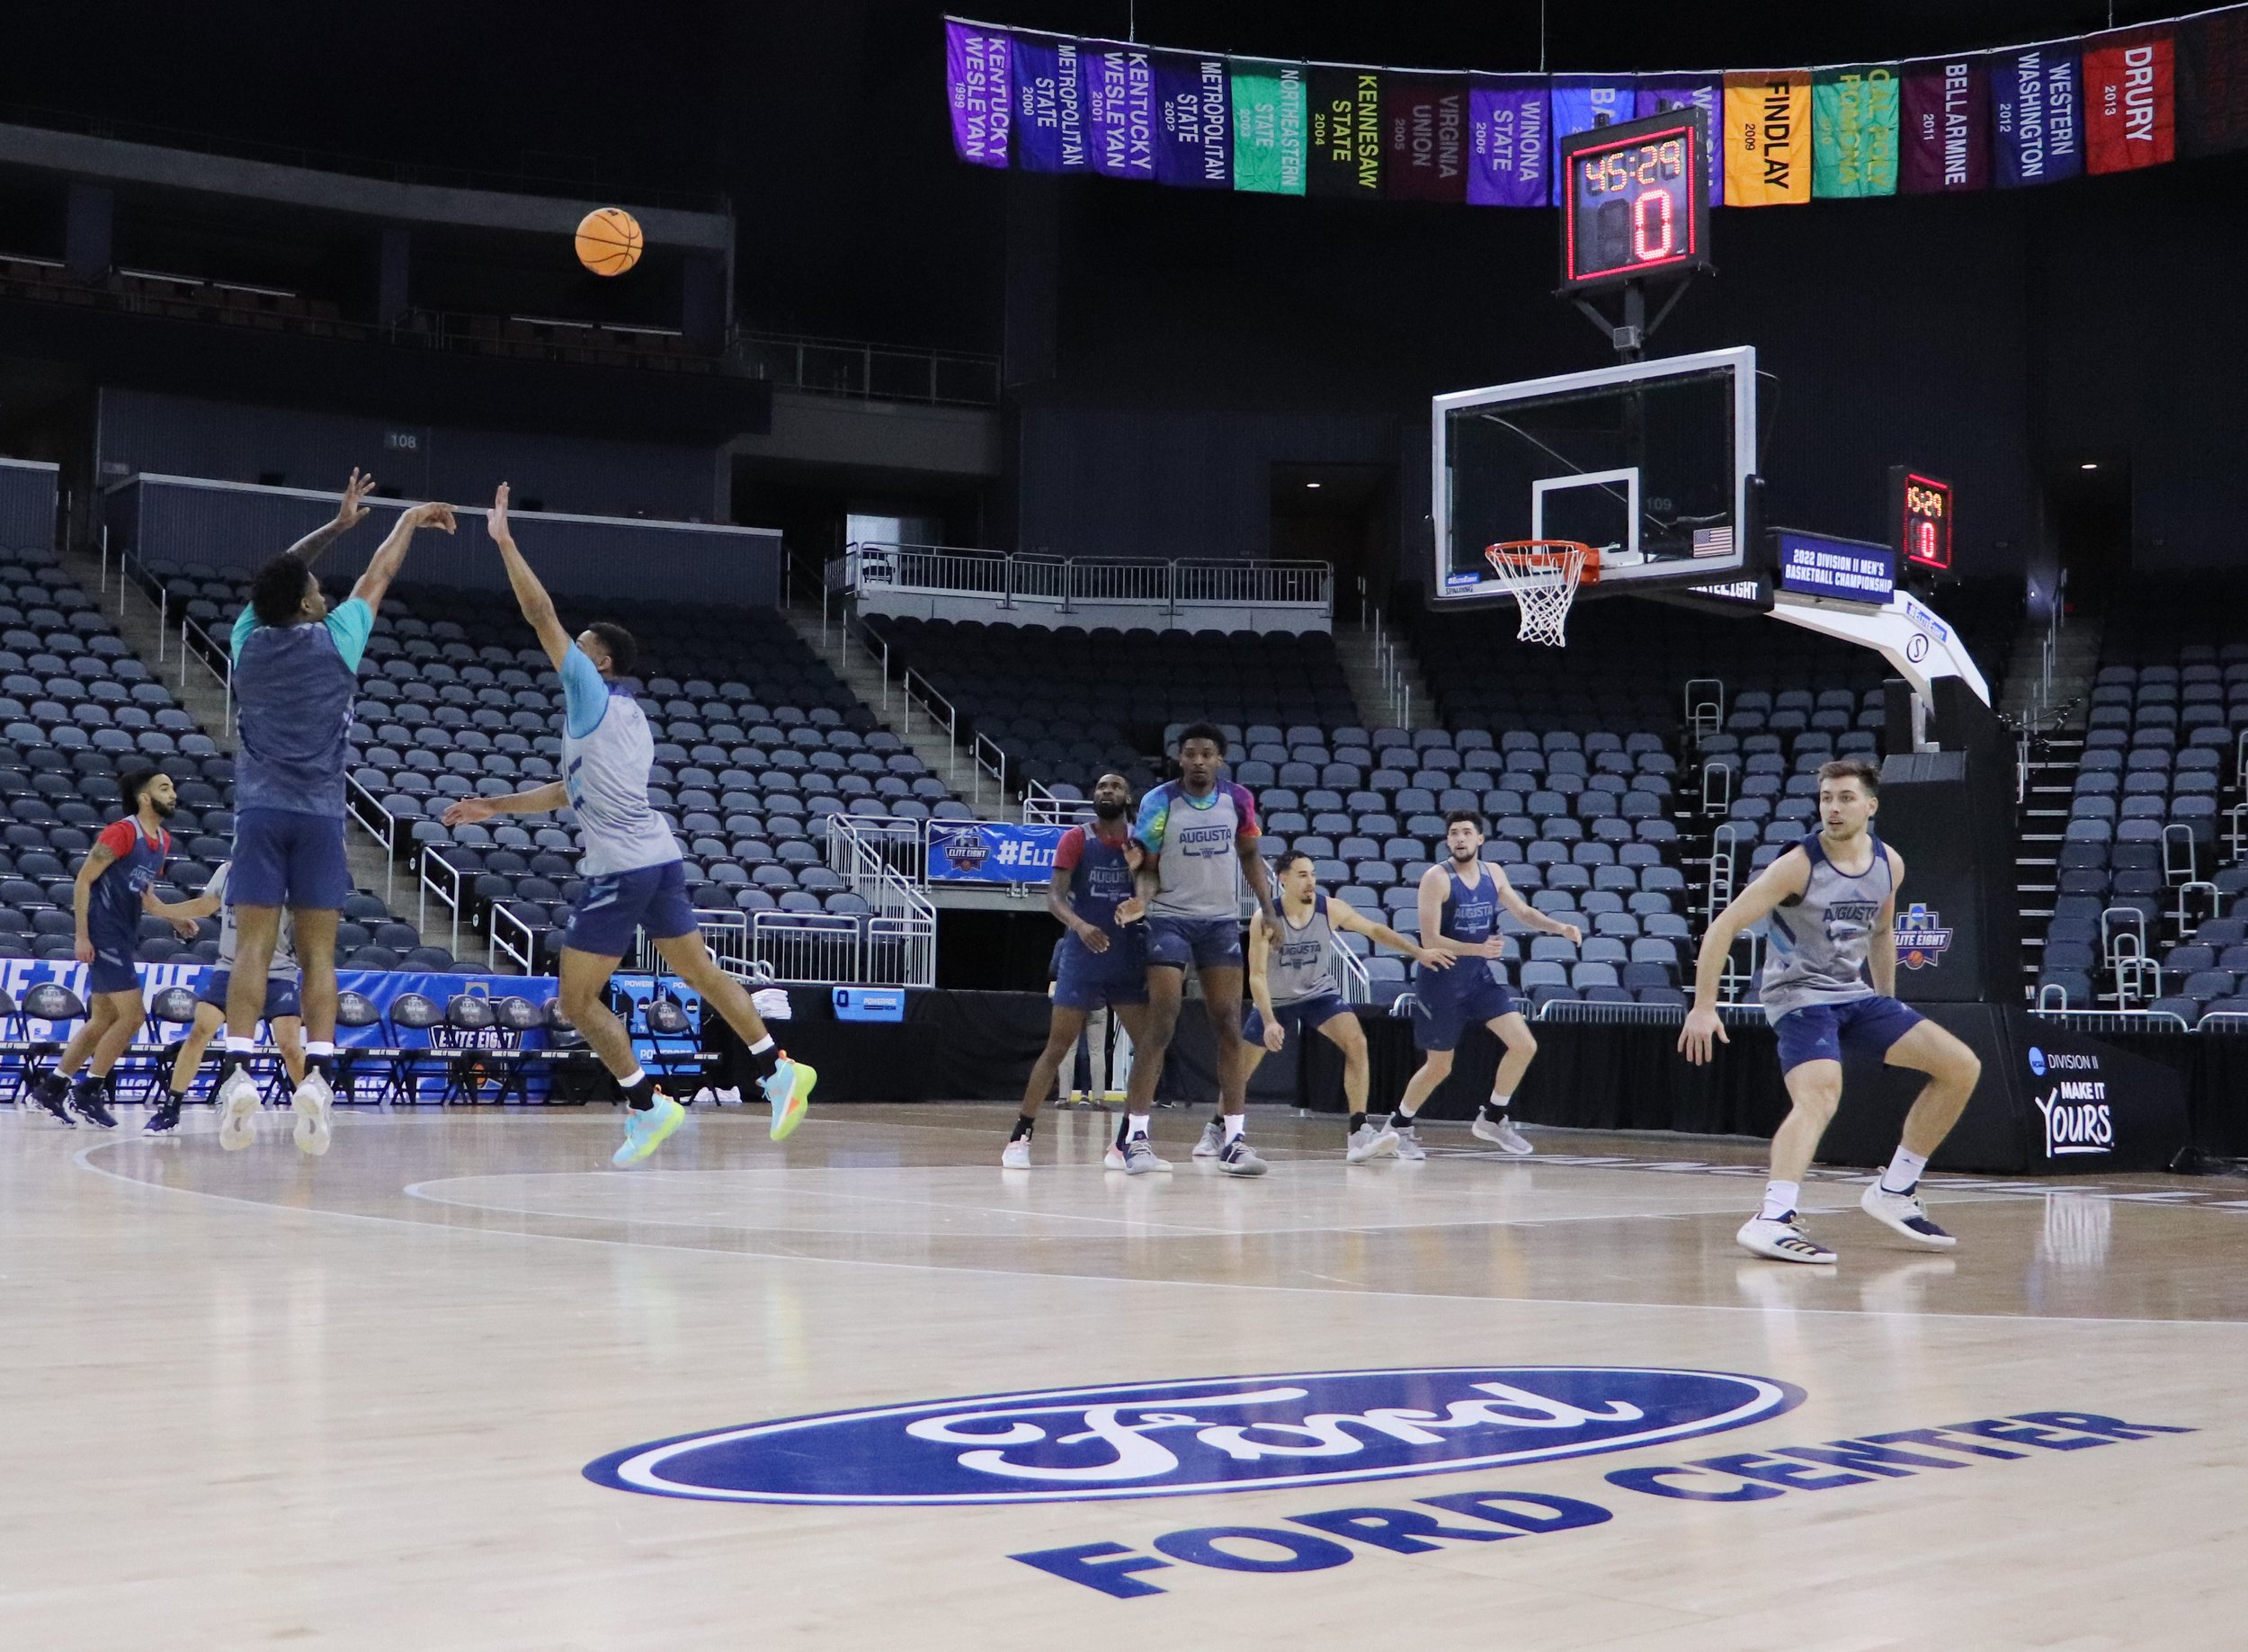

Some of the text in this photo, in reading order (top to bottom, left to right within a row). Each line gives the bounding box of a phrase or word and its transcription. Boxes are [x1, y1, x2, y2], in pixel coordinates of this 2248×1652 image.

[954, 82, 965, 109] 1999
[964, 37, 985, 157] WESLEYAN
[987, 37, 1010, 159] KENTUCKY
[1021, 86, 1034, 116] 2000
[1035, 77, 1057, 128] STATE
[1057, 44, 1084, 165] METROPOLITAN
[1091, 91, 1102, 122] 2001
[1103, 52, 1126, 168] WESLEYAN
[1128, 52, 1153, 170] KENTUCKY
[1164, 101, 1175, 132] 2002
[1177, 94, 1200, 143] STATE
[1999, 103, 2012, 133] 2012
[2018, 51, 2044, 178] WASHINGTON
[2048, 63, 2073, 155] WESTERN
[2104, 85, 2117, 116] 2013
[2125, 46, 2154, 141] DRURY
[1200, 62, 1226, 180] METROPOLITAN
[1253, 103, 1274, 147] STATE
[1280, 68, 1300, 186] NORTHEASTERN
[1315, 113, 1325, 146] 2004
[1331, 100, 1352, 162] STATE
[1356, 75, 1378, 189] KENNESAW
[1394, 118, 1405, 151] 2005
[1412, 104, 1432, 167] UNION
[1438, 94, 1459, 180] VIRGINIA
[1476, 121, 1487, 155] 2006
[1492, 110, 1512, 172] STATE
[1520, 101, 1541, 182] WINONA
[1744, 122, 1756, 151] 2009
[1763, 81, 1790, 190] FINDLAY
[1839, 74, 1861, 185] POMONA
[1868, 69, 1891, 187] CAL POLY
[1922, 113, 1934, 141] 2011
[1944, 64, 1967, 185] BELLARMINE
[1585, 140, 1681, 192] 45:29
[1635, 189, 1671, 260] 0
[391, 433, 416, 449] 108
[1793, 549, 1815, 565] 2022
[1816, 552, 1851, 569] DIVISION
[1860, 558, 1885, 576] MEN'S
[1921, 522, 1934, 558] 0
[1785, 564, 1893, 594] BASKETBALL CHAMPIONSHIP
[949, 849, 986, 858] ELITE EIGHT
[1180, 828, 1232, 844] AUGUSTA
[1454, 905, 1493, 919] AUGUSTA
[1894, 934, 1946, 946] LITE EIGHT
[2047, 1054, 2092, 1069] DIVISION
[2092, 1056, 2099, 1069] II
[2061, 1082, 2105, 1099] MAKE IT
[905, 1381, 1643, 1482] Ford
[1006, 1410, 2202, 1599] FORD CENTER
